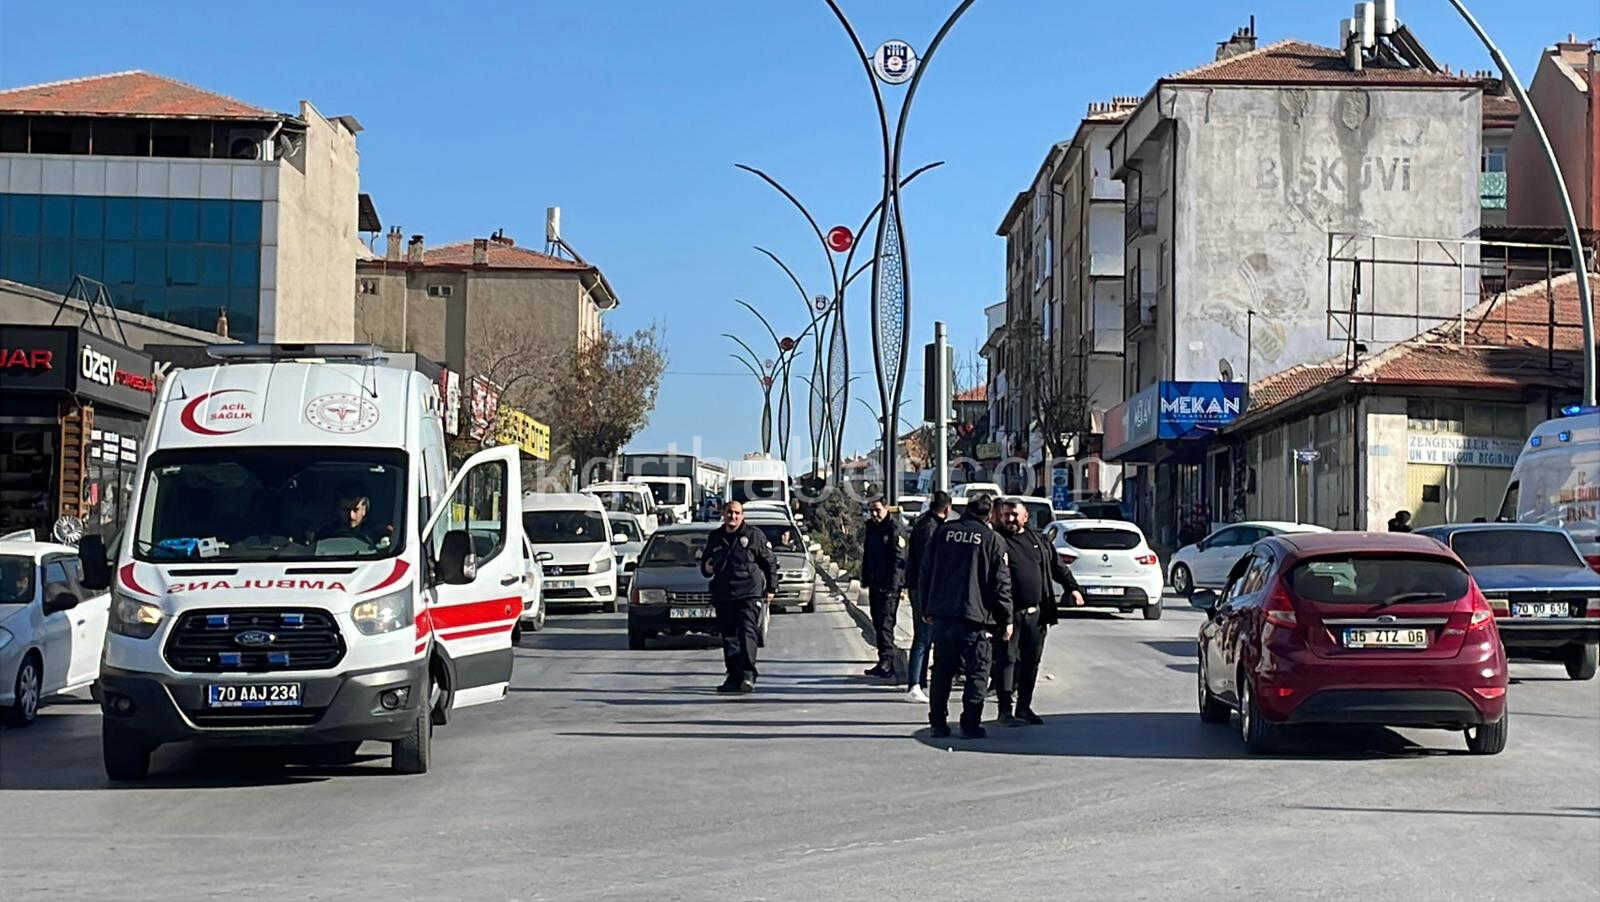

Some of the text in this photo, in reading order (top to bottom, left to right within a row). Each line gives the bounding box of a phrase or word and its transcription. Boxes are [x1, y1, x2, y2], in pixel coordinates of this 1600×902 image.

[82, 344, 118, 386] ÖZEV
[1160, 396, 1240, 414] MEKAN
[210, 411, 253, 420] SAĞLIK
[1409, 448, 1421, 460] UN
[1376, 630, 1399, 643] ZTZ
[1408, 630, 1424, 643] 06
[218, 685, 298, 700] 70 AAJ 234
